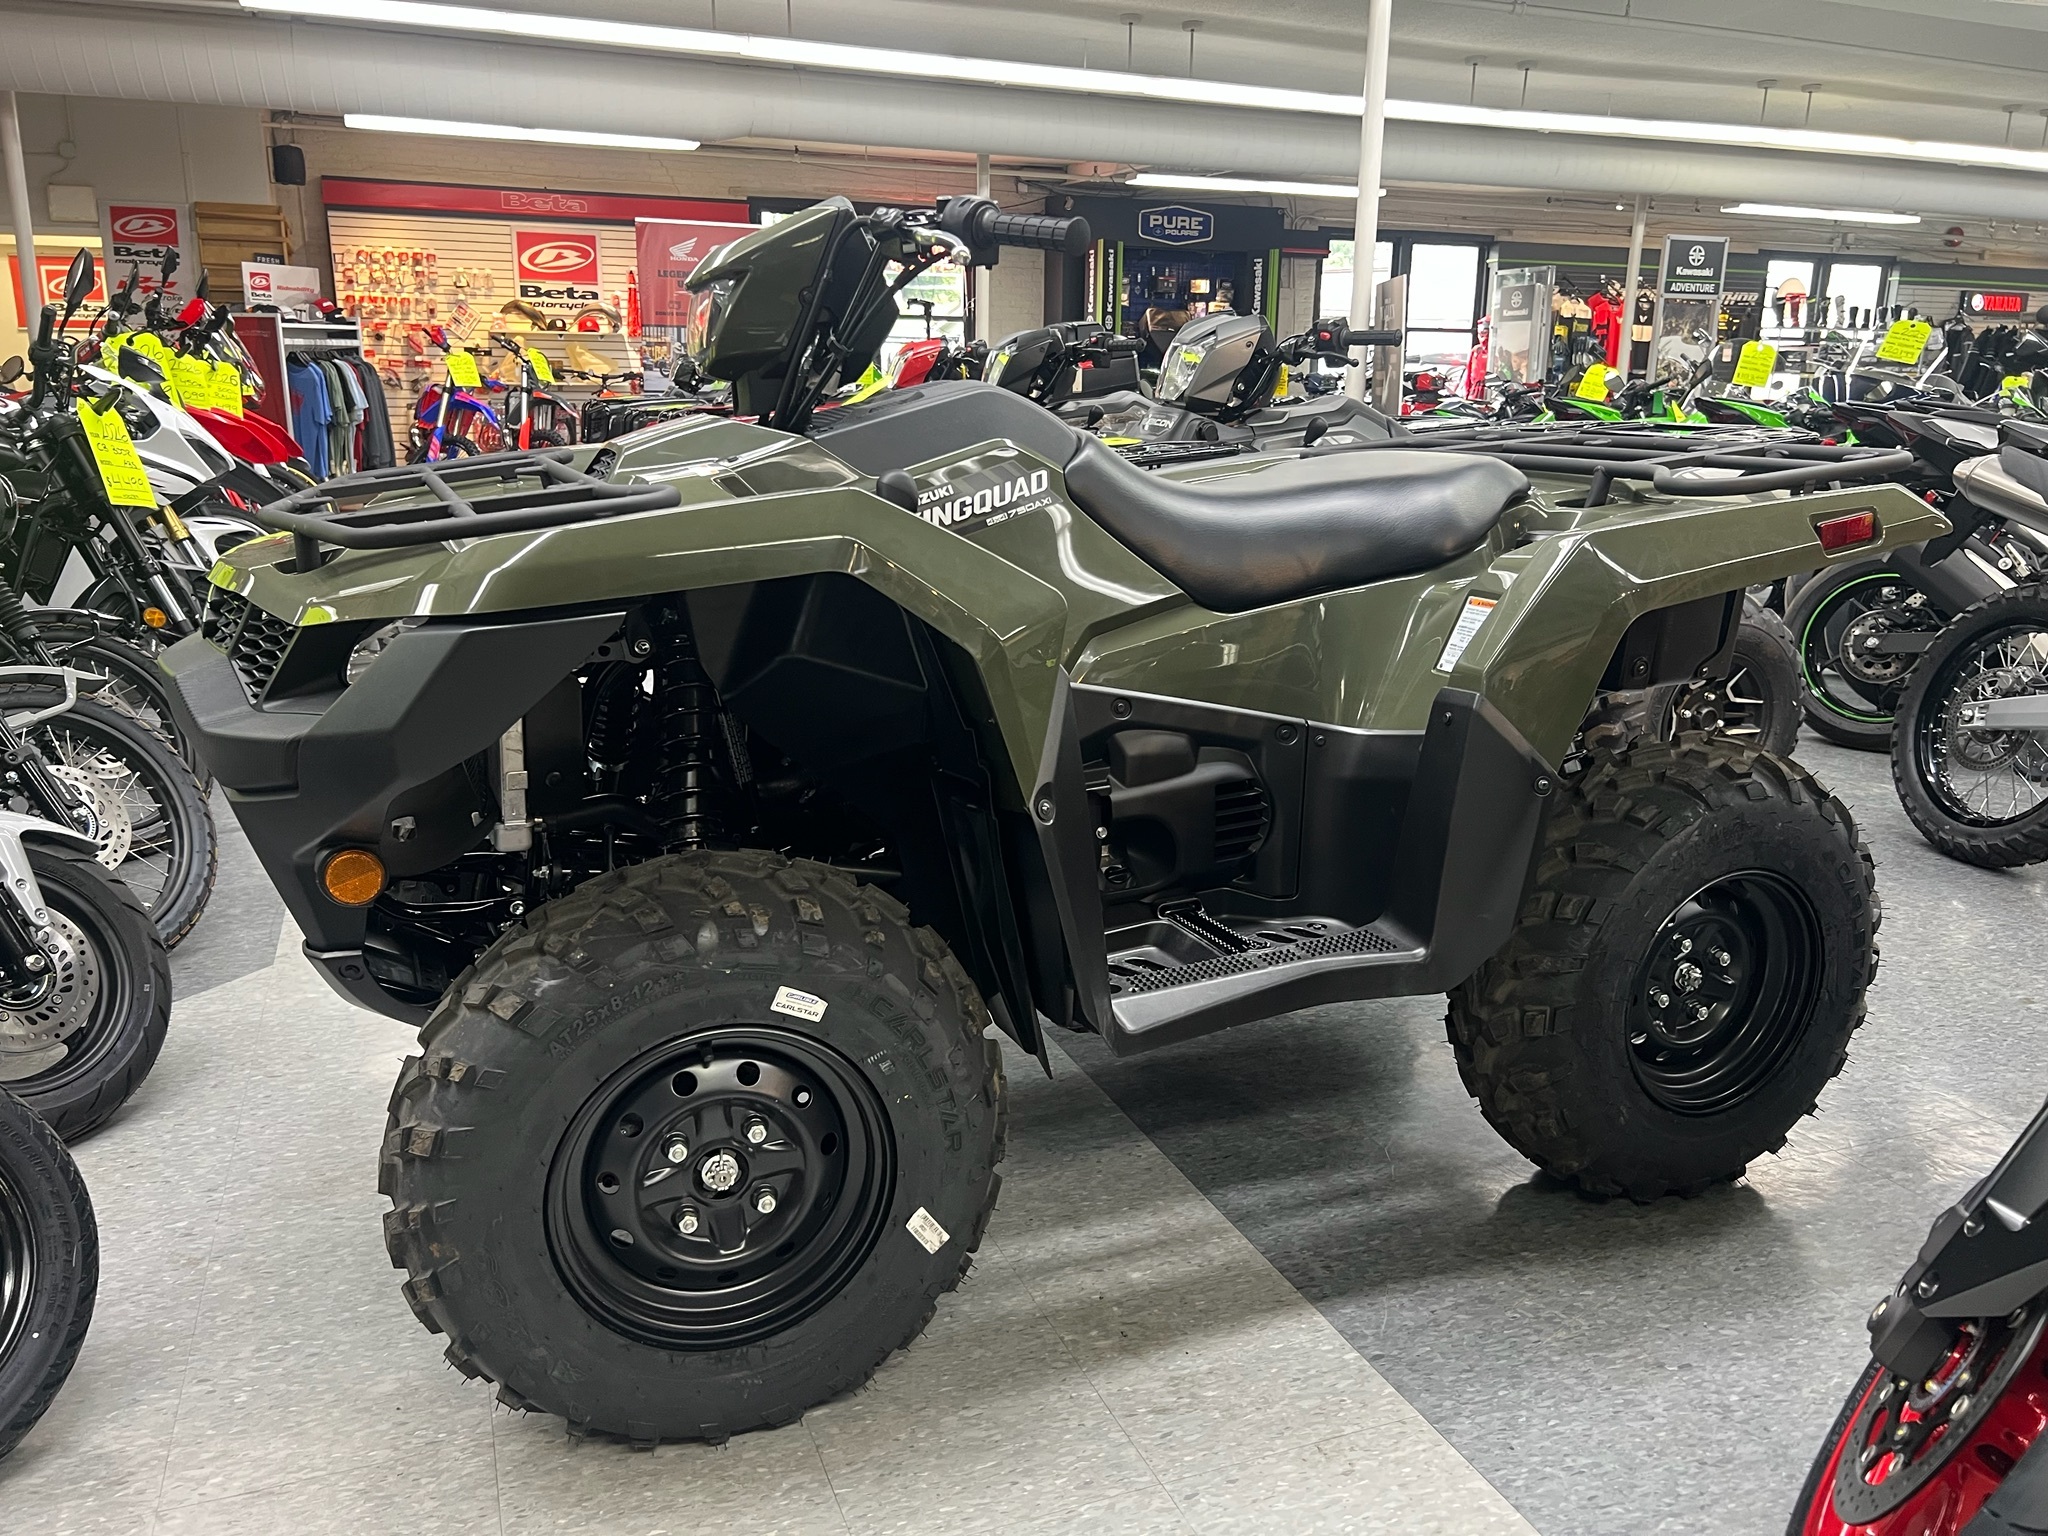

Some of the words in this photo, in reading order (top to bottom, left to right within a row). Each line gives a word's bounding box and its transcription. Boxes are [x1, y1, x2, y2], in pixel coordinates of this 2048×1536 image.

[501, 191, 588, 213] Beta
[1149, 214, 1204, 230] PURE
[1164, 229, 1199, 237] POLARIS
[113, 246, 180, 259] Bet
[256, 256, 281, 264] FRESH
[1675, 266, 1714, 277] Kawasaki
[1087, 249, 1095, 313] Kawasaki
[1106, 248, 1115, 313] Kawasaki
[1670, 282, 1716, 293] ADVENTURE
[520, 285, 599, 300] Beta
[1983, 295, 2022, 312] YAMAHA
[915, 469, 1049, 527] INGQUAD
[918, 484, 955, 506] ZUKI
[776, 1002, 820, 1017] CARLSTAR
